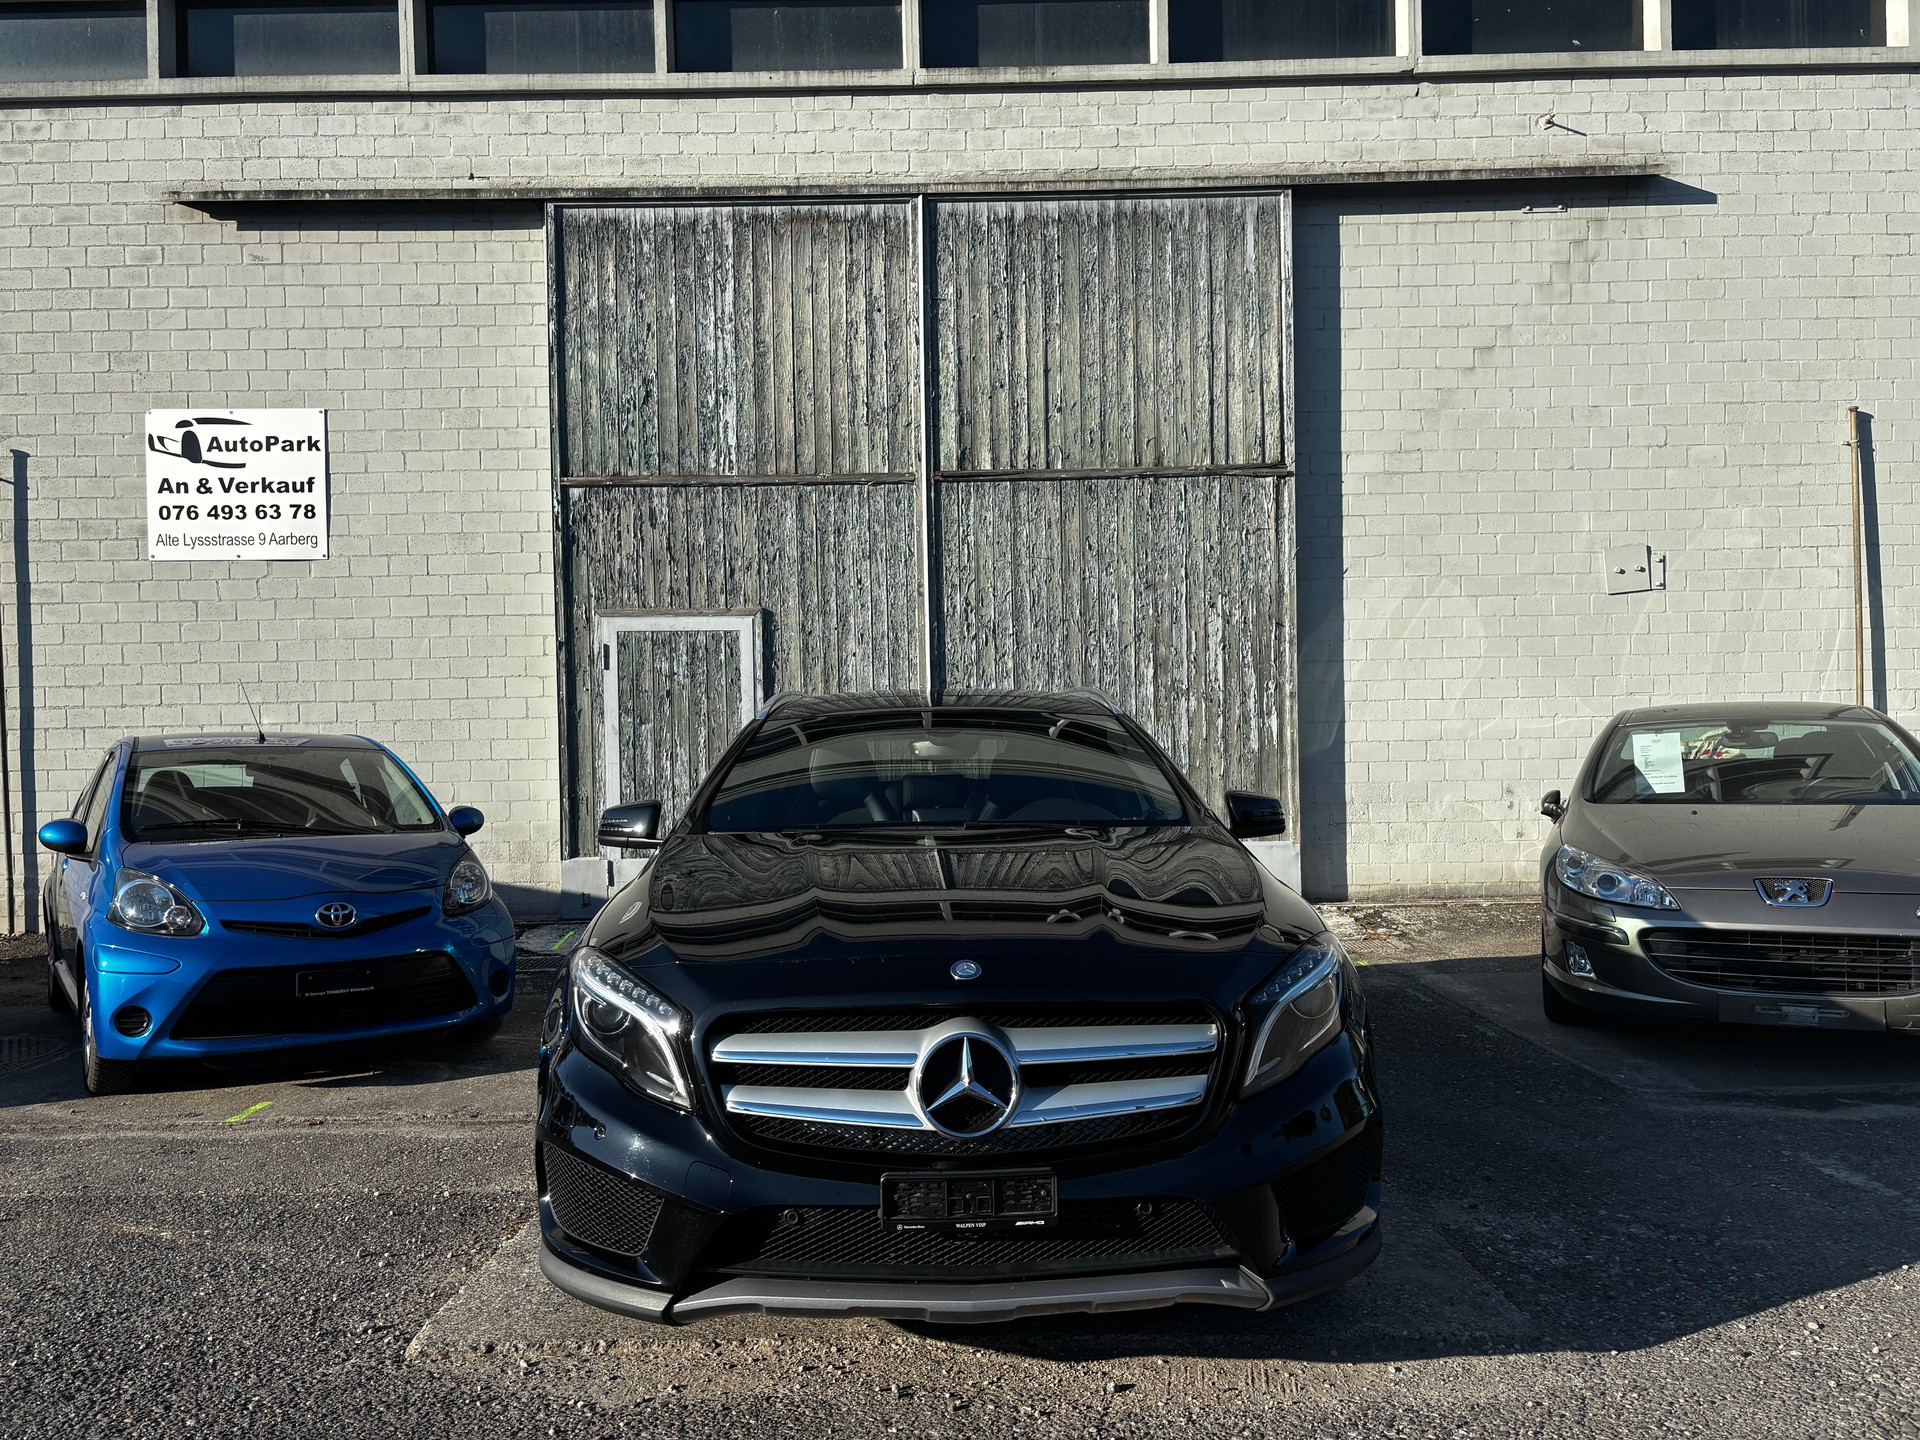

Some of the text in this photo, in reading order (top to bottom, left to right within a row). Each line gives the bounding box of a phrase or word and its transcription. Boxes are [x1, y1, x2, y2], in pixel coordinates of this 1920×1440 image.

[206, 436, 321, 452] AutoPark
[157, 477, 315, 494] An & Verkauf
[158, 504, 316, 520] 076 493 63 78
[156, 532, 318, 549] Alte Lyssstrasse 9 Aarberg
